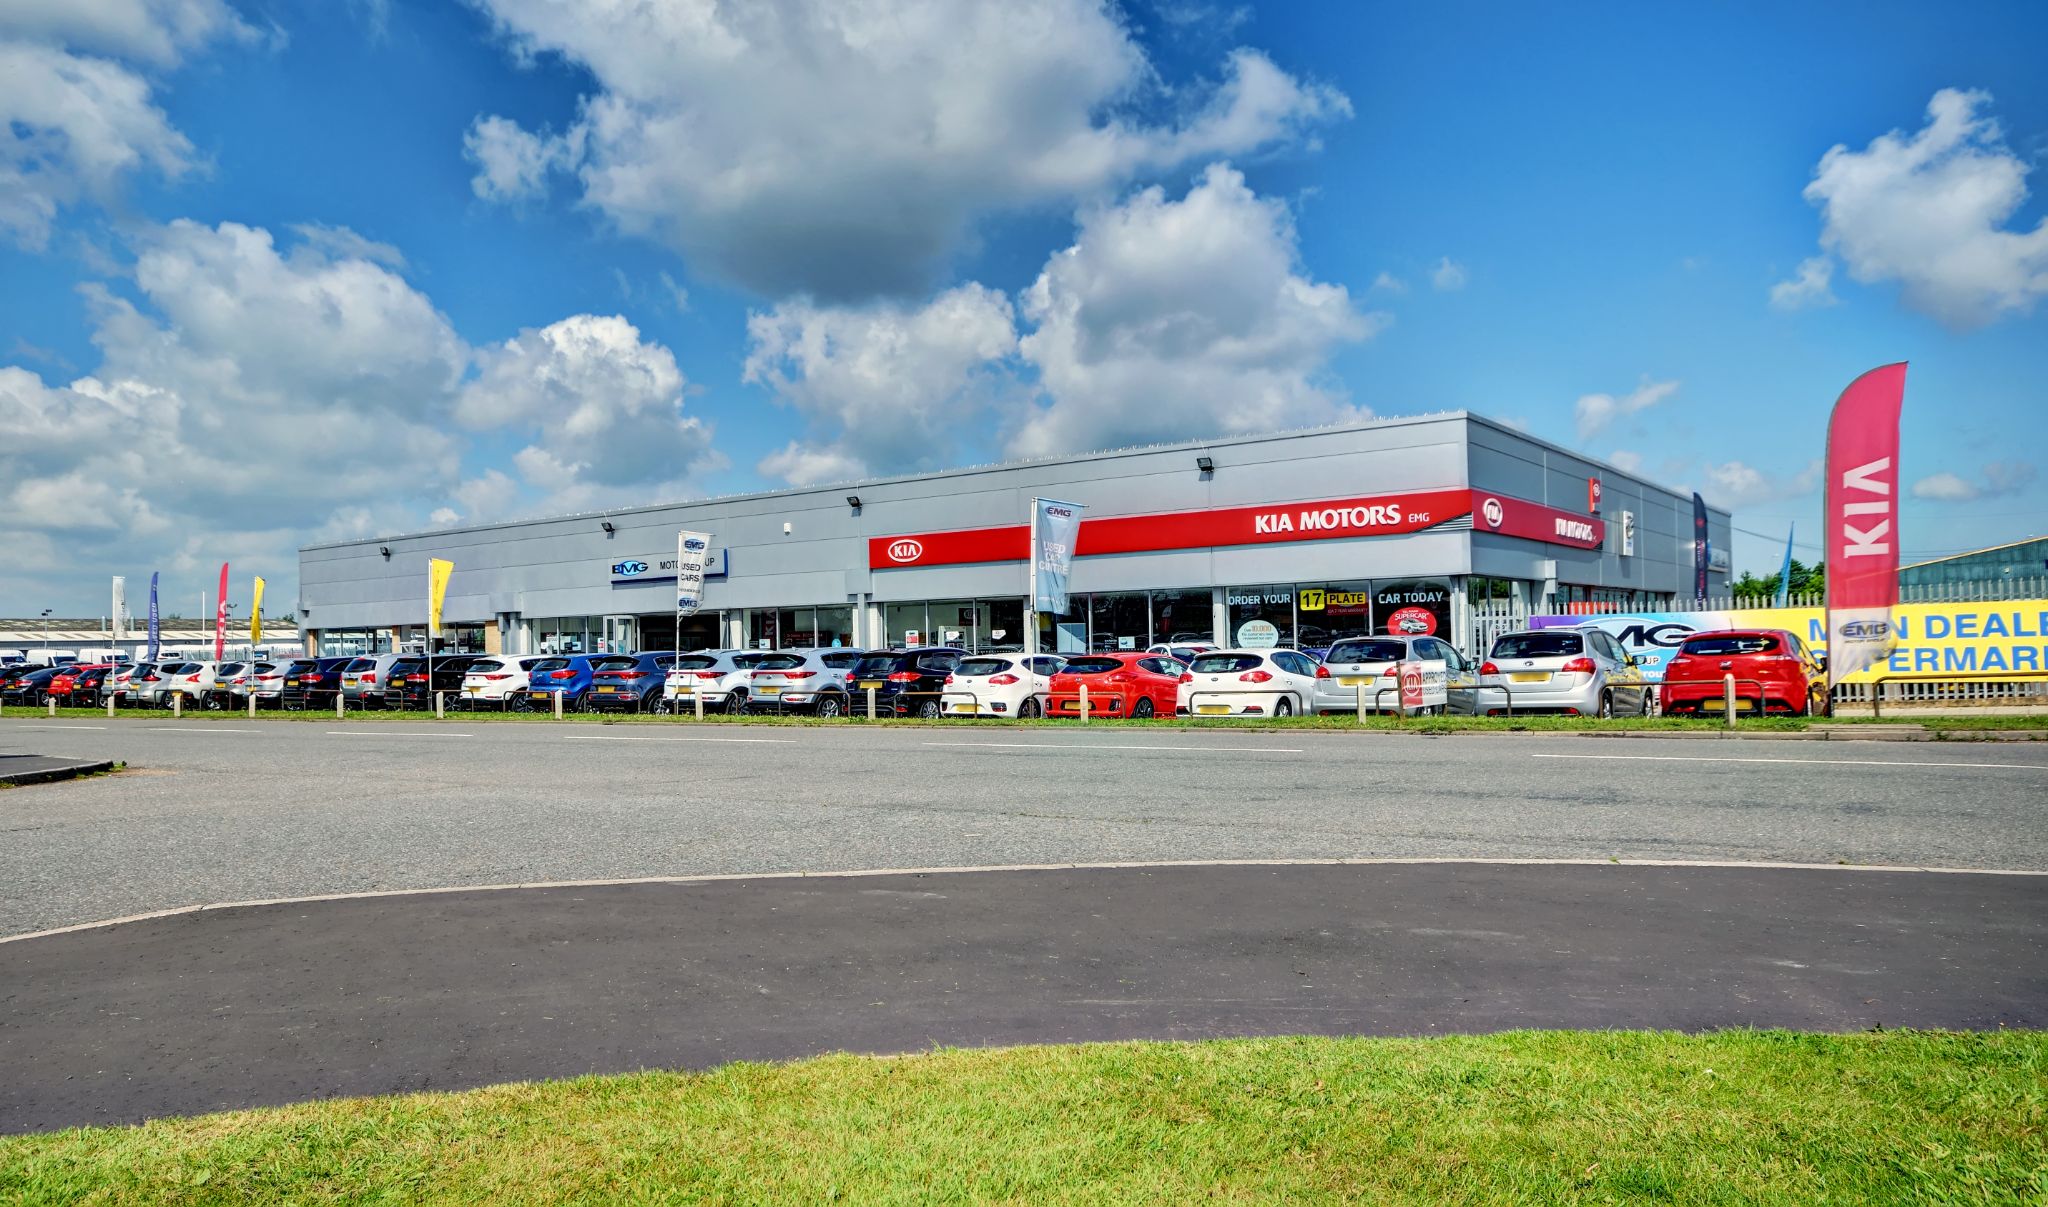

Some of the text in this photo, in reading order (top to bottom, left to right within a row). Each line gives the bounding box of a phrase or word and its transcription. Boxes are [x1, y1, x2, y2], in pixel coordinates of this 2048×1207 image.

[1047, 507, 1071, 517] EMG
[1843, 457, 1890, 558] KIA
[1255, 504, 1430, 534] KIA MOTORS EMG
[894, 544, 917, 557] KIA
[1043, 541, 1066, 554] USED
[612, 562, 649, 574] EMG
[1229, 593, 1291, 606] ORDER YOUR
[1302, 593, 1322, 607] 17
[1329, 593, 1364, 604] PLATE
[1378, 591, 1443, 604] CAR TODAY
[1842, 623, 1887, 636] EMG
